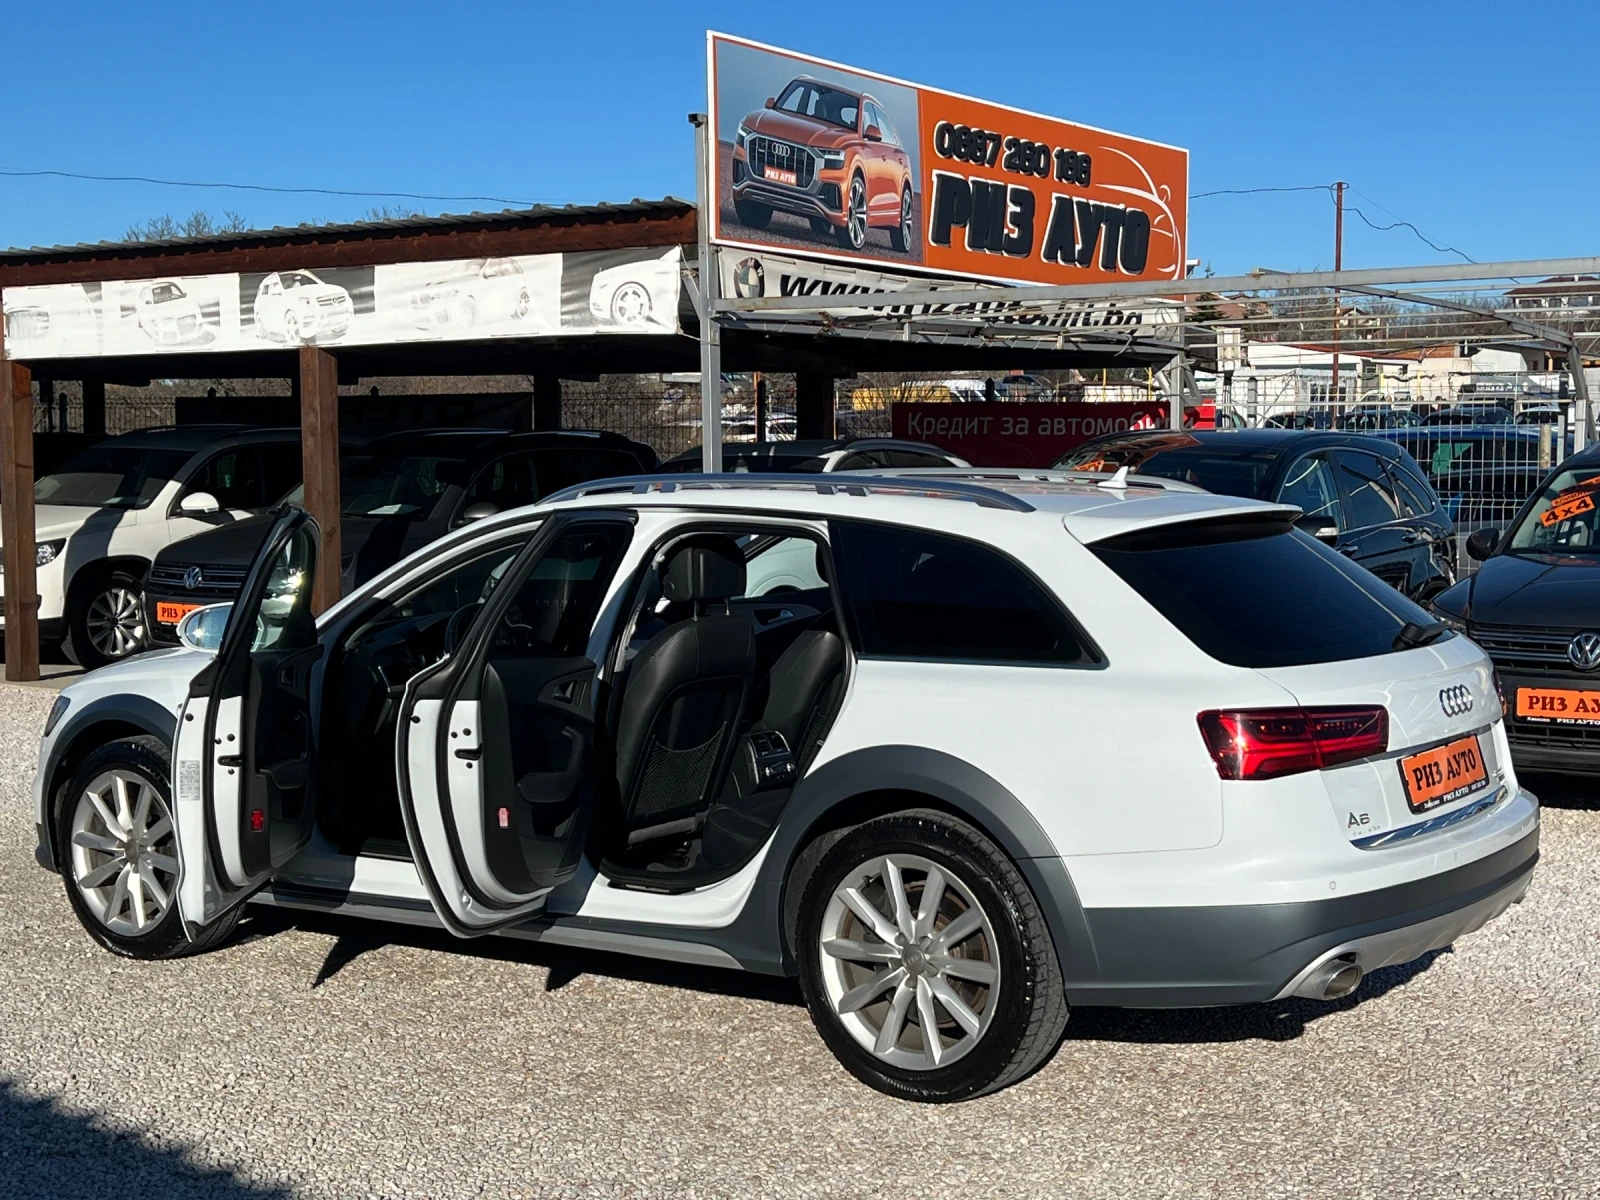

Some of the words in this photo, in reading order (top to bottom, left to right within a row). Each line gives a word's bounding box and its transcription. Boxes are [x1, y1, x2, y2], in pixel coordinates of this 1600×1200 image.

[935, 121, 1001, 167] 0887
[929, 169, 1035, 257] РИЗ
[1041, 192, 1150, 275] АУТО
[907, 412, 994, 440] Кредит
[1000, 417, 1029, 435] за
[1528, 696, 1567, 711] РИЗ
[1412, 761, 1443, 791] РИЗ
[1447, 748, 1476, 780] АУТО
[1348, 812, 1370, 828] A6
